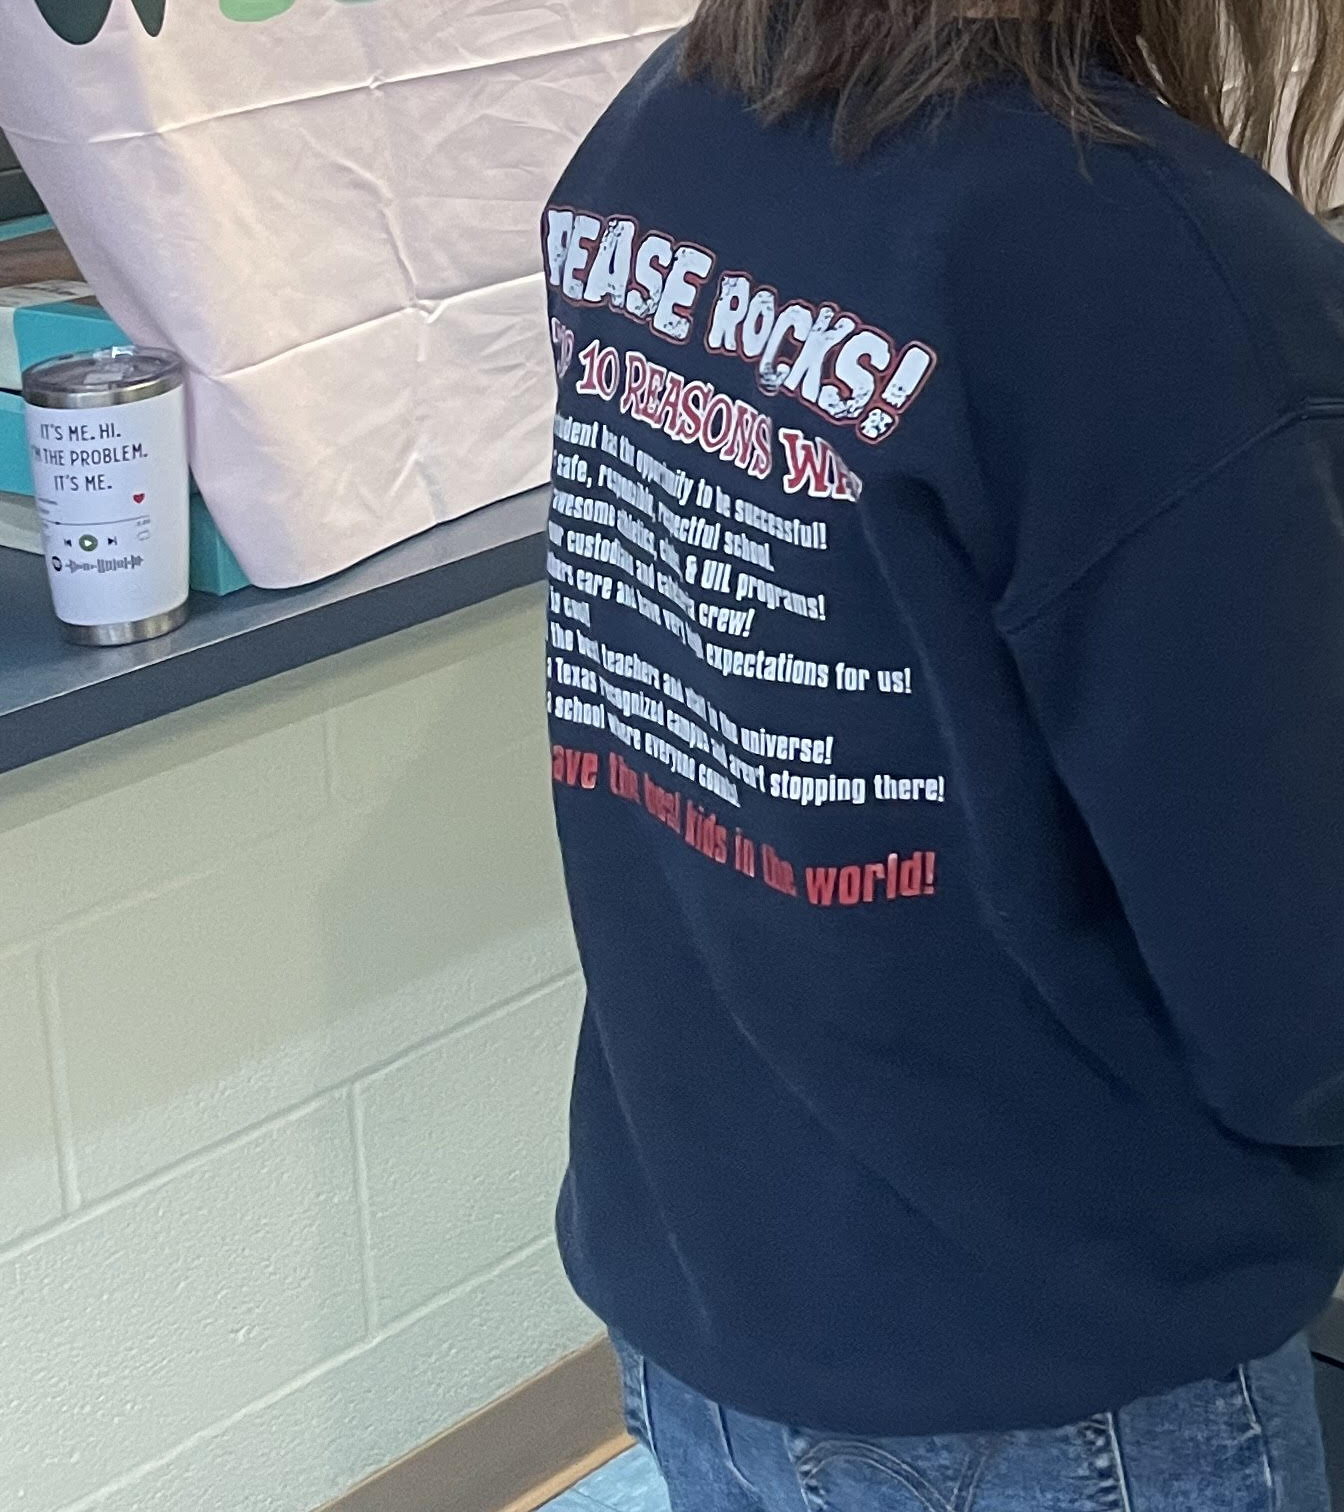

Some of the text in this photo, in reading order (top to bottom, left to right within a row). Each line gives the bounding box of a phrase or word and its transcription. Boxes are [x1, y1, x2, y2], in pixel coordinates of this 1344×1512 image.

[543, 206, 937, 445] PEASE ROCKS!
[40, 422, 122, 441] IT'S ME. HI.
[576, 339, 620, 402] 10
[620, 352, 772, 480] REASONS
[43, 448, 66, 467] THE
[69, 442, 149, 467] PROBLEM.
[54, 473, 113, 492] IT'S ME.
[557, 454, 592, 488] safe,
[696, 479, 713, 508] to
[734, 499, 828, 550] successful!
[685, 555, 698, 585] &
[736, 573, 826, 621] programs!
[699, 602, 755, 638] crew!
[576, 569, 613, 600] care
[706, 643, 828, 688] expectations
[835, 662, 870, 691] for
[877, 667, 912, 694] us!
[555, 695, 605, 730] school
[555, 656, 598, 694] Texas
[769, 769, 866, 807] stopping
[873, 773, 945, 803] there!
[601, 644, 661, 691] teachers
[740, 728, 834, 766] universe!
[552, 744, 599, 790] ave
[684, 799, 728, 865] kids
[734, 826, 756, 879] in
[805, 850, 937, 907] world!
